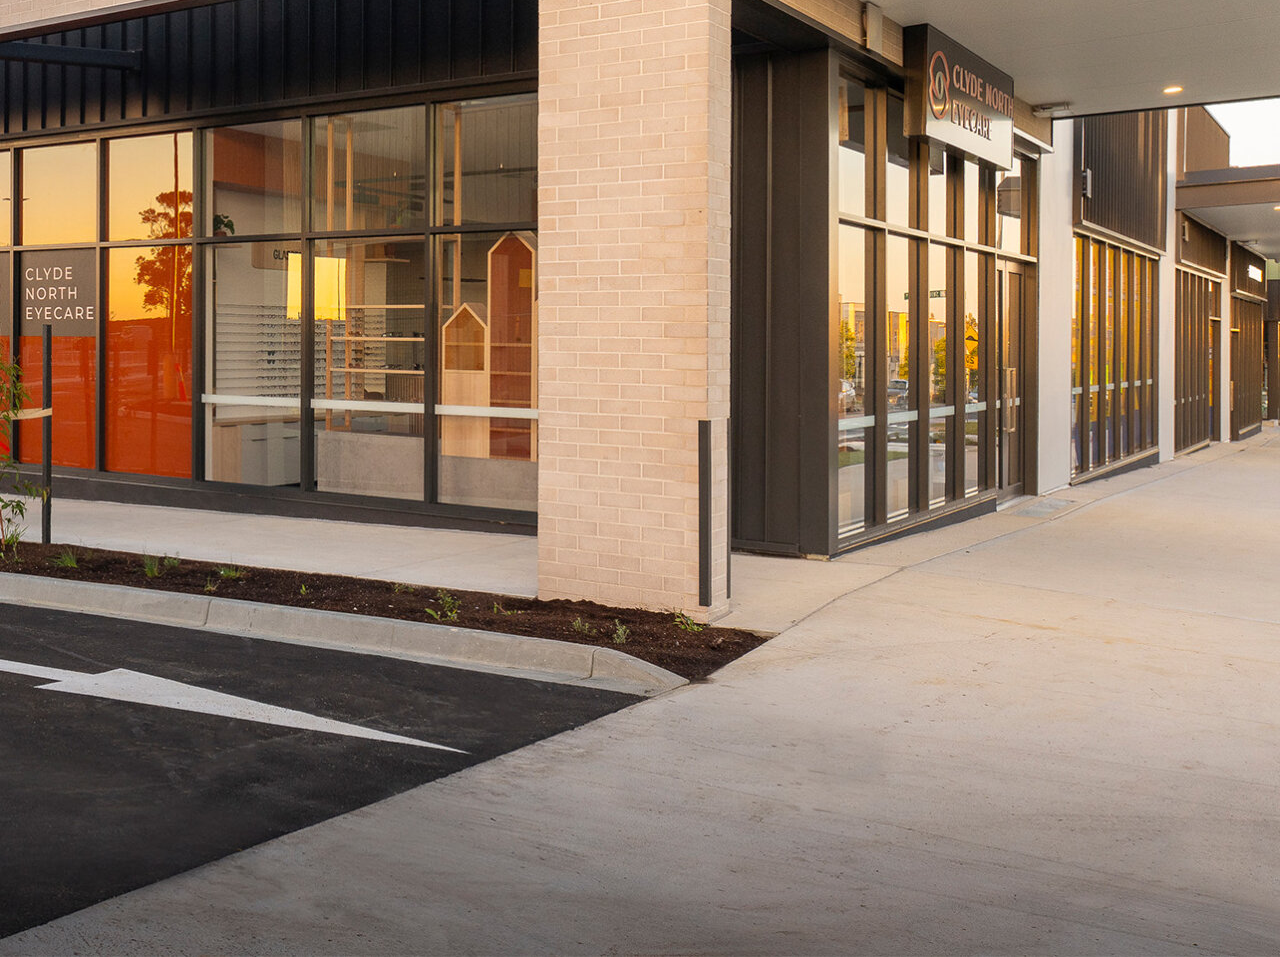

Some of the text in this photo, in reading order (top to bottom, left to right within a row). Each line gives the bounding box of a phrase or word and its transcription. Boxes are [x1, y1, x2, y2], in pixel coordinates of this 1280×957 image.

[952, 64, 1014, 119] CLYDE NORTH
[951, 99, 992, 141] EYECARE
[25, 266, 73, 281] CLYDE
[25, 286, 78, 300] NORTH
[25, 306, 95, 320] EYECARE
